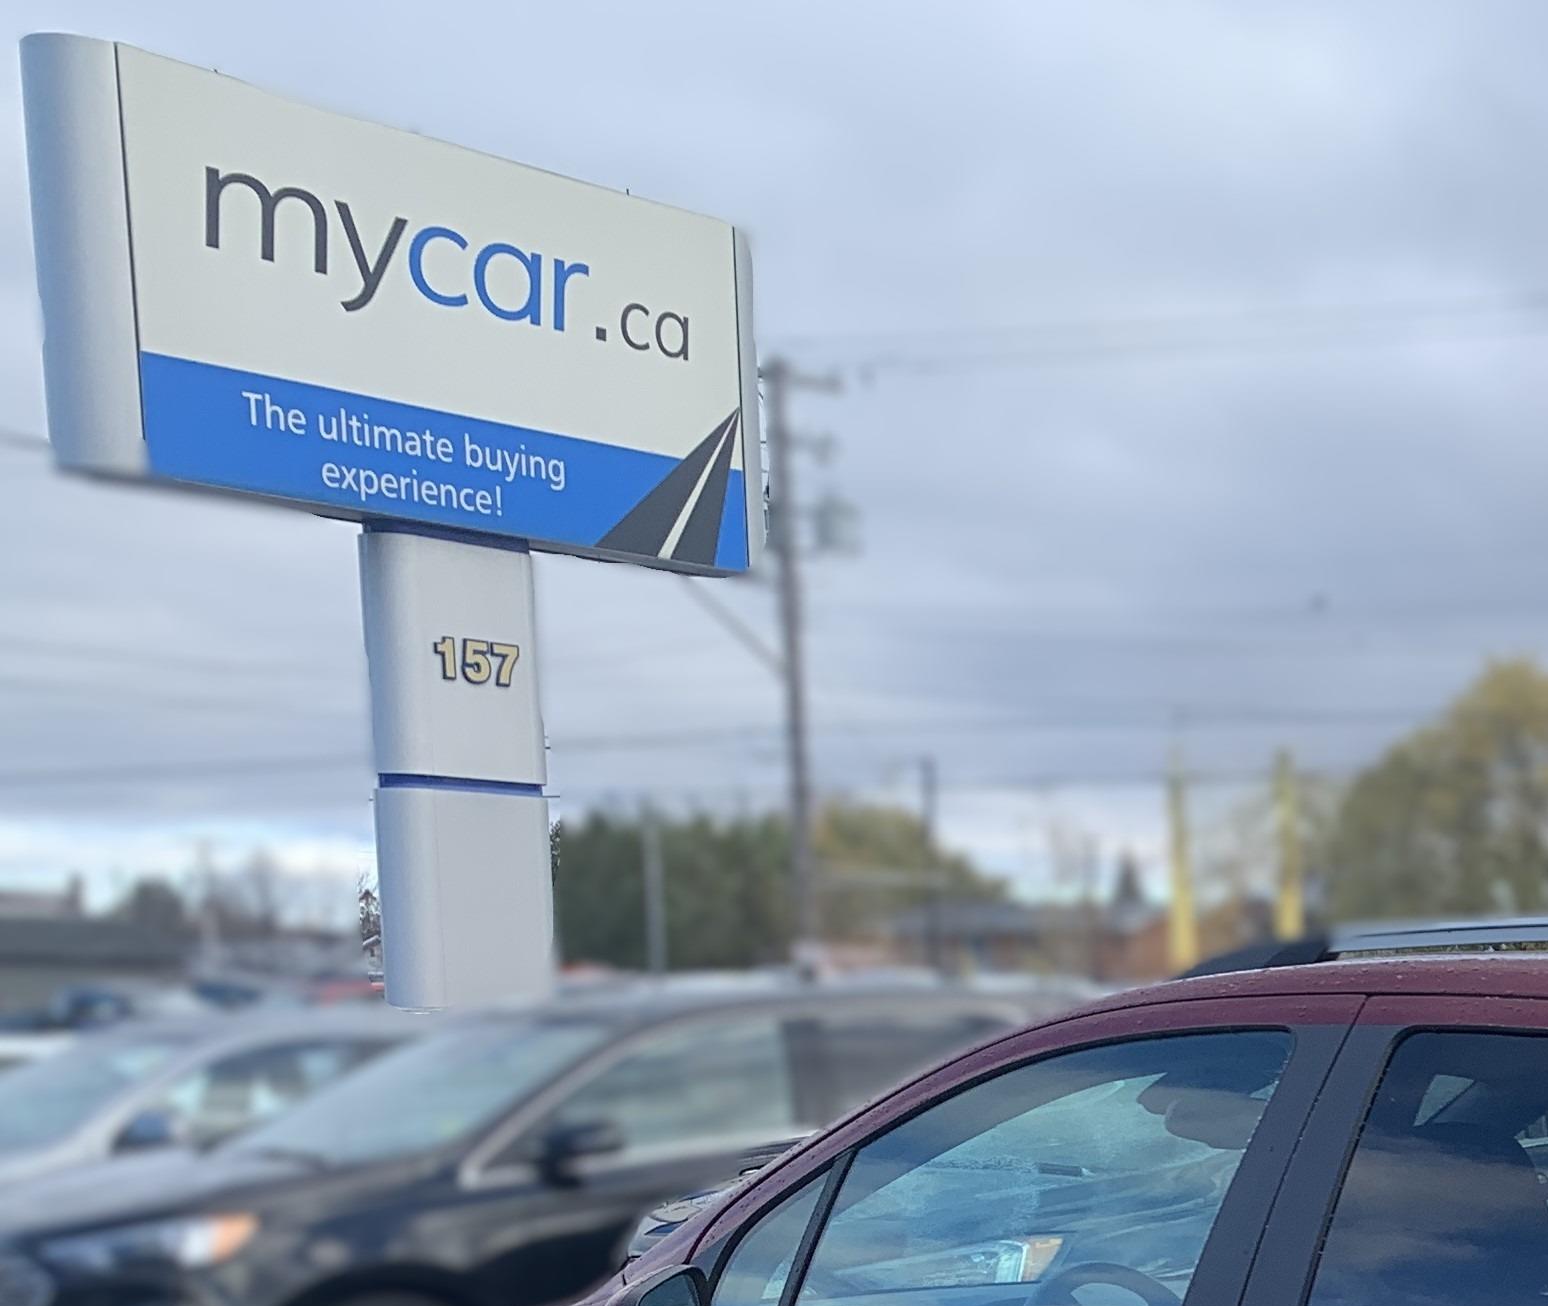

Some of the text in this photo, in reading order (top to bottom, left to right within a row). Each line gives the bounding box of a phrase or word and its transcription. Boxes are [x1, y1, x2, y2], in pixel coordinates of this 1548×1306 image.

[205, 165, 690, 361] mycar.ca
[241, 391, 566, 491] The ultimate buying
[321, 461, 503, 517] experience!
[433, 635, 520, 688] 157
